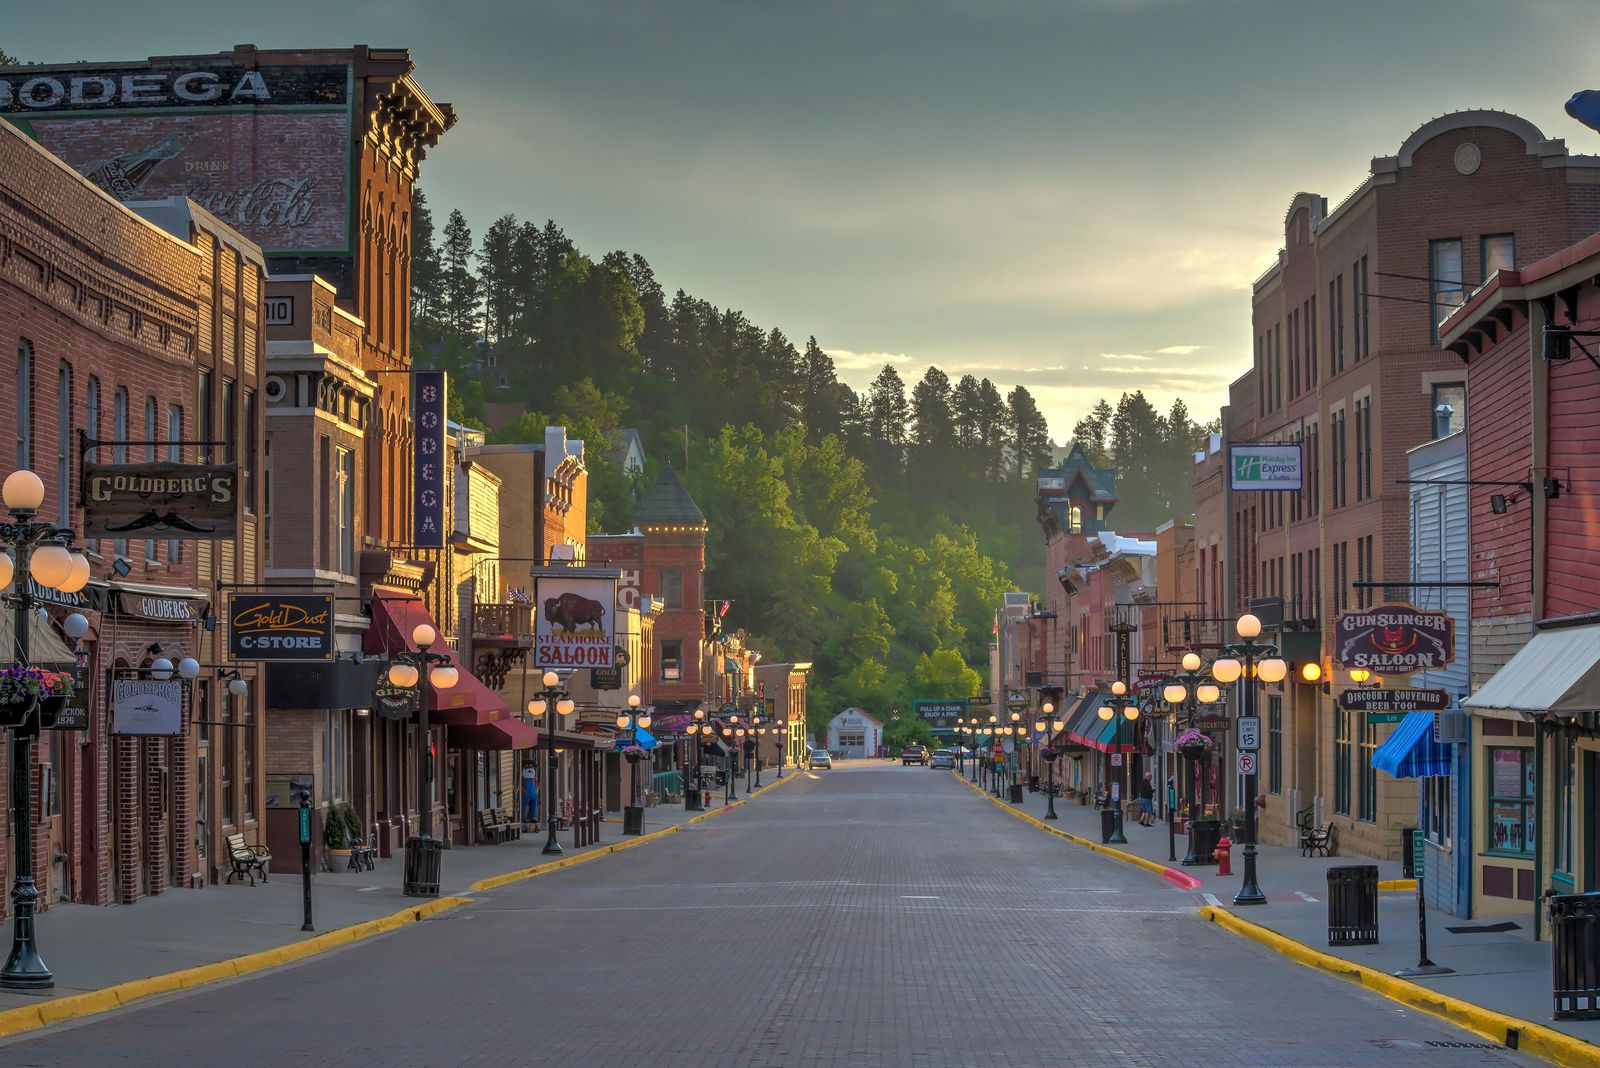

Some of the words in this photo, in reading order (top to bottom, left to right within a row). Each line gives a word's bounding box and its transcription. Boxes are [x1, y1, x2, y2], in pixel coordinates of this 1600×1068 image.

[0, 71, 271, 107] ODEGA
[185, 160, 230, 171] DRINK
[421, 385, 438, 533] BODEGA
[1262, 455, 1285, 463] Holiday
[1262, 464, 1297, 474] Express
[91, 473, 231, 503] GOLDBERG'S
[233, 603, 283, 628] Gold
[269, 604, 328, 628] Dust
[1343, 614, 1446, 631] GUNSLINGER
[538, 635, 612, 645] STEAKHOUSE
[540, 646, 610, 665] SALOON
[1354, 653, 1435, 667] SALOON
[375, 688, 414, 697] GIFT
[1347, 691, 1389, 704] DISCOUNT
[1394, 690, 1440, 703] SOUVENIRS
[1243, 734, 1254, 745] 15
